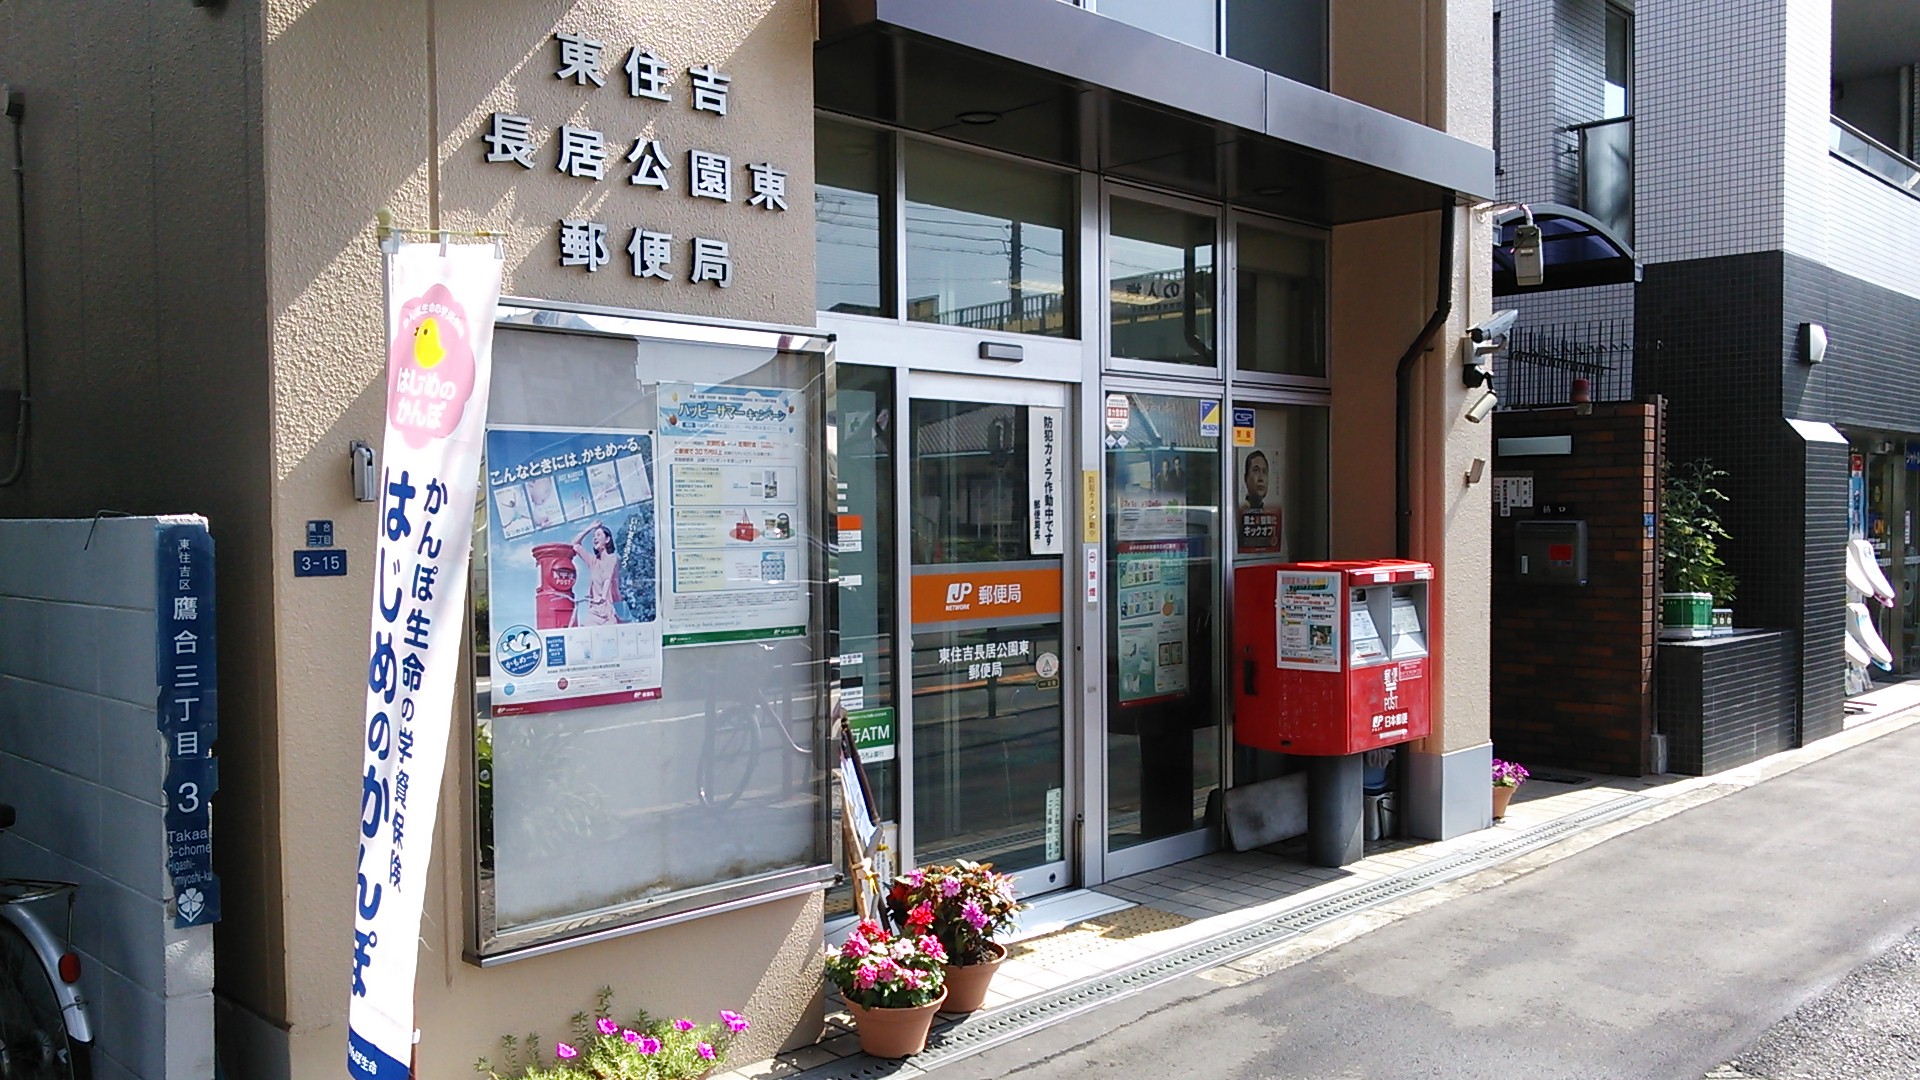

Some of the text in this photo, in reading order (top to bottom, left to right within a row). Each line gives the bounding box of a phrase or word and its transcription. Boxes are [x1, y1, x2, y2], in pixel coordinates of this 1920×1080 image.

[554, 32, 732, 116] 東住吉
[483, 112, 789, 212] 長居公園東
[559, 219, 734, 288] 郵便局
[396, 367, 456, 397] はじめの
[396, 400, 448, 429] かんぽ
[1043, 416, 1054, 546] 防犯カメラ作動中です
[308, 535, 331, 545] 三丁目
[178, 538, 191, 591] 東住吉区
[301, 555, 340, 571] 3-15
[945, 582, 973, 604] JP
[978, 583, 1022, 605] 郵便局
[945, 603, 970, 612] NETWORK
[938, 640, 1030, 664] 東住吉長居公園東
[173, 596, 200, 756] 鷹合三丁目
[968, 662, 1003, 681] 郵便局
[1383, 695, 1399, 712] POST
[178, 782, 199, 813] 3
[169, 843, 212, 858] 3-chome
